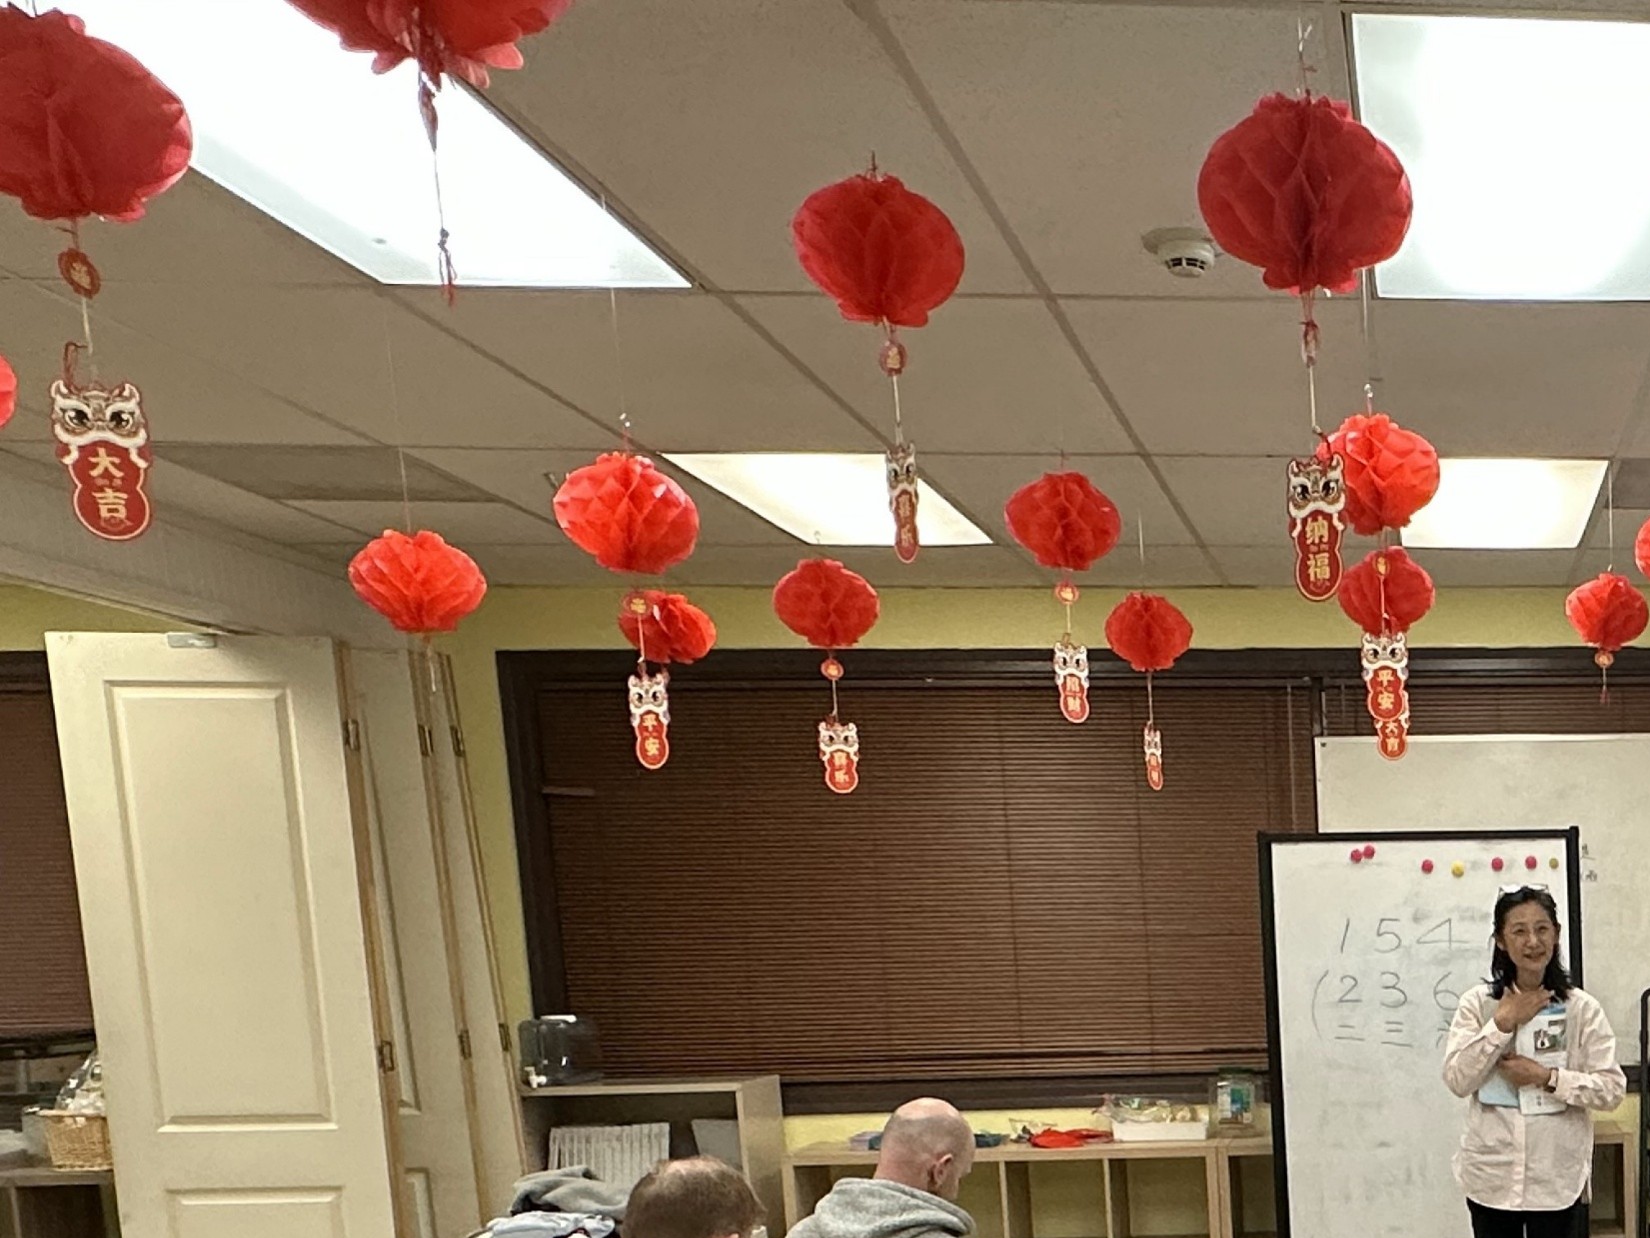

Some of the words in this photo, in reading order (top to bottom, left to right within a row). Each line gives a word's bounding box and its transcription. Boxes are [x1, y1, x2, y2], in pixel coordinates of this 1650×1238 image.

[87, 447, 129, 519] 大吉
[1305, 516, 1331, 582] 纳福
[1377, 669, 1396, 710] 平安
[1374, 918, 1402, 954] 5
[1416, 917, 1470, 951] 4
